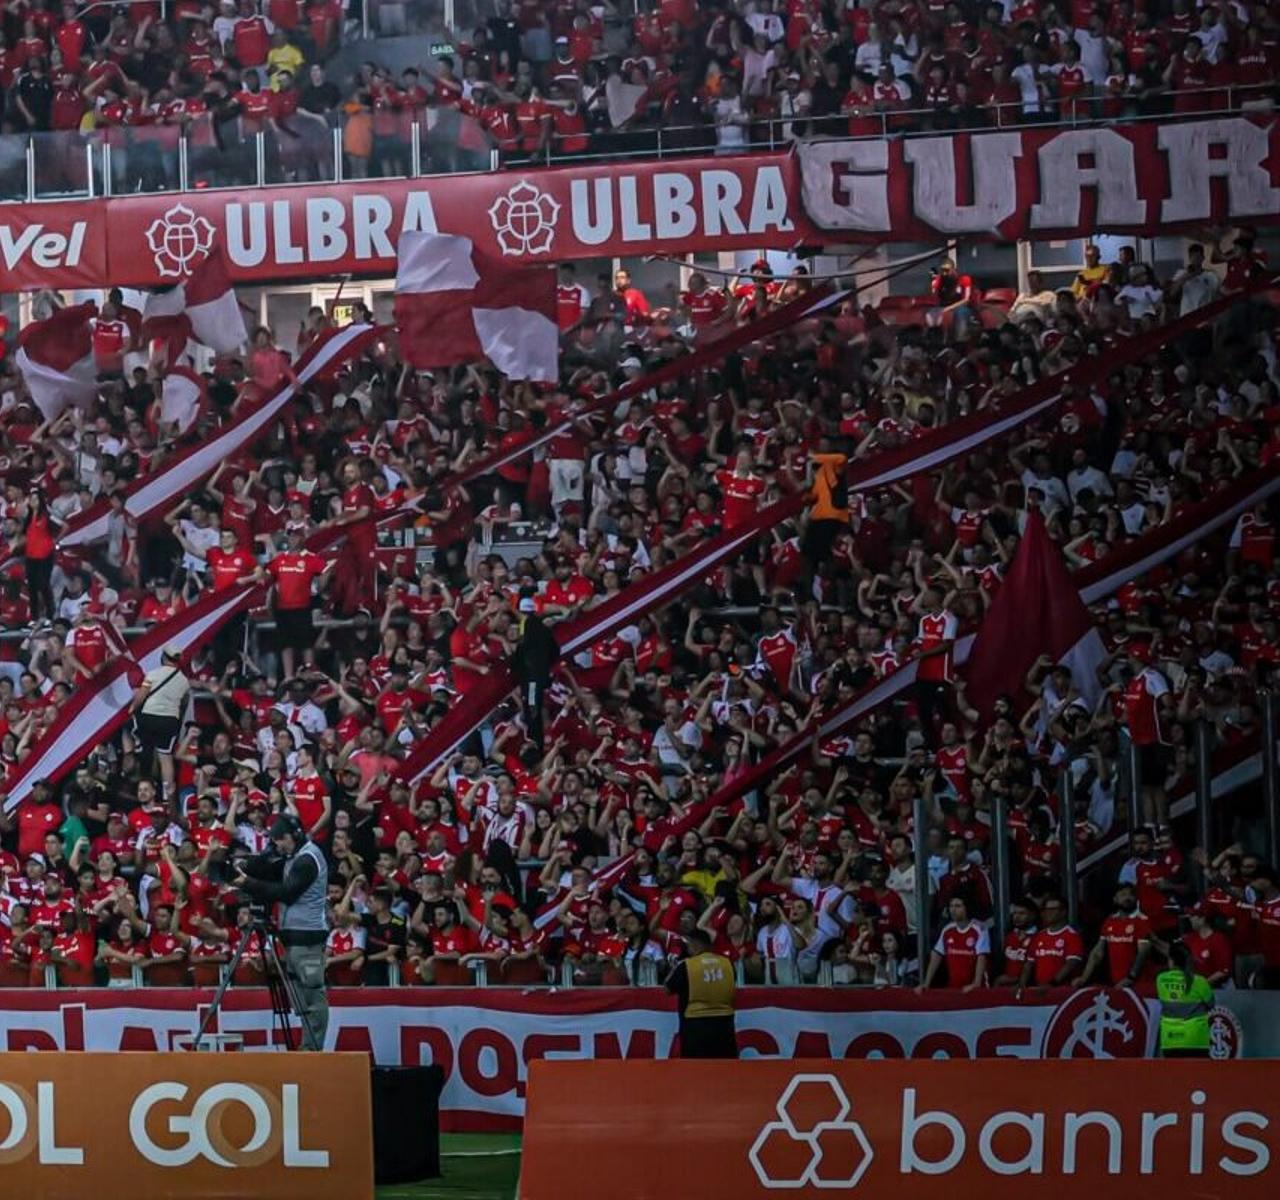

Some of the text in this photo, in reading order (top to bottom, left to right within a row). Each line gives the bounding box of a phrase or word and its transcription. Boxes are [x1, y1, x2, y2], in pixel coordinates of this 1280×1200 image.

[570, 165, 795, 246] ULBRA
[800, 117, 1280, 234] GUAR
[225, 190, 439, 269] ULBRA
[130, 1081, 330, 1168] GOL
[899, 1088, 1272, 1176] banris
